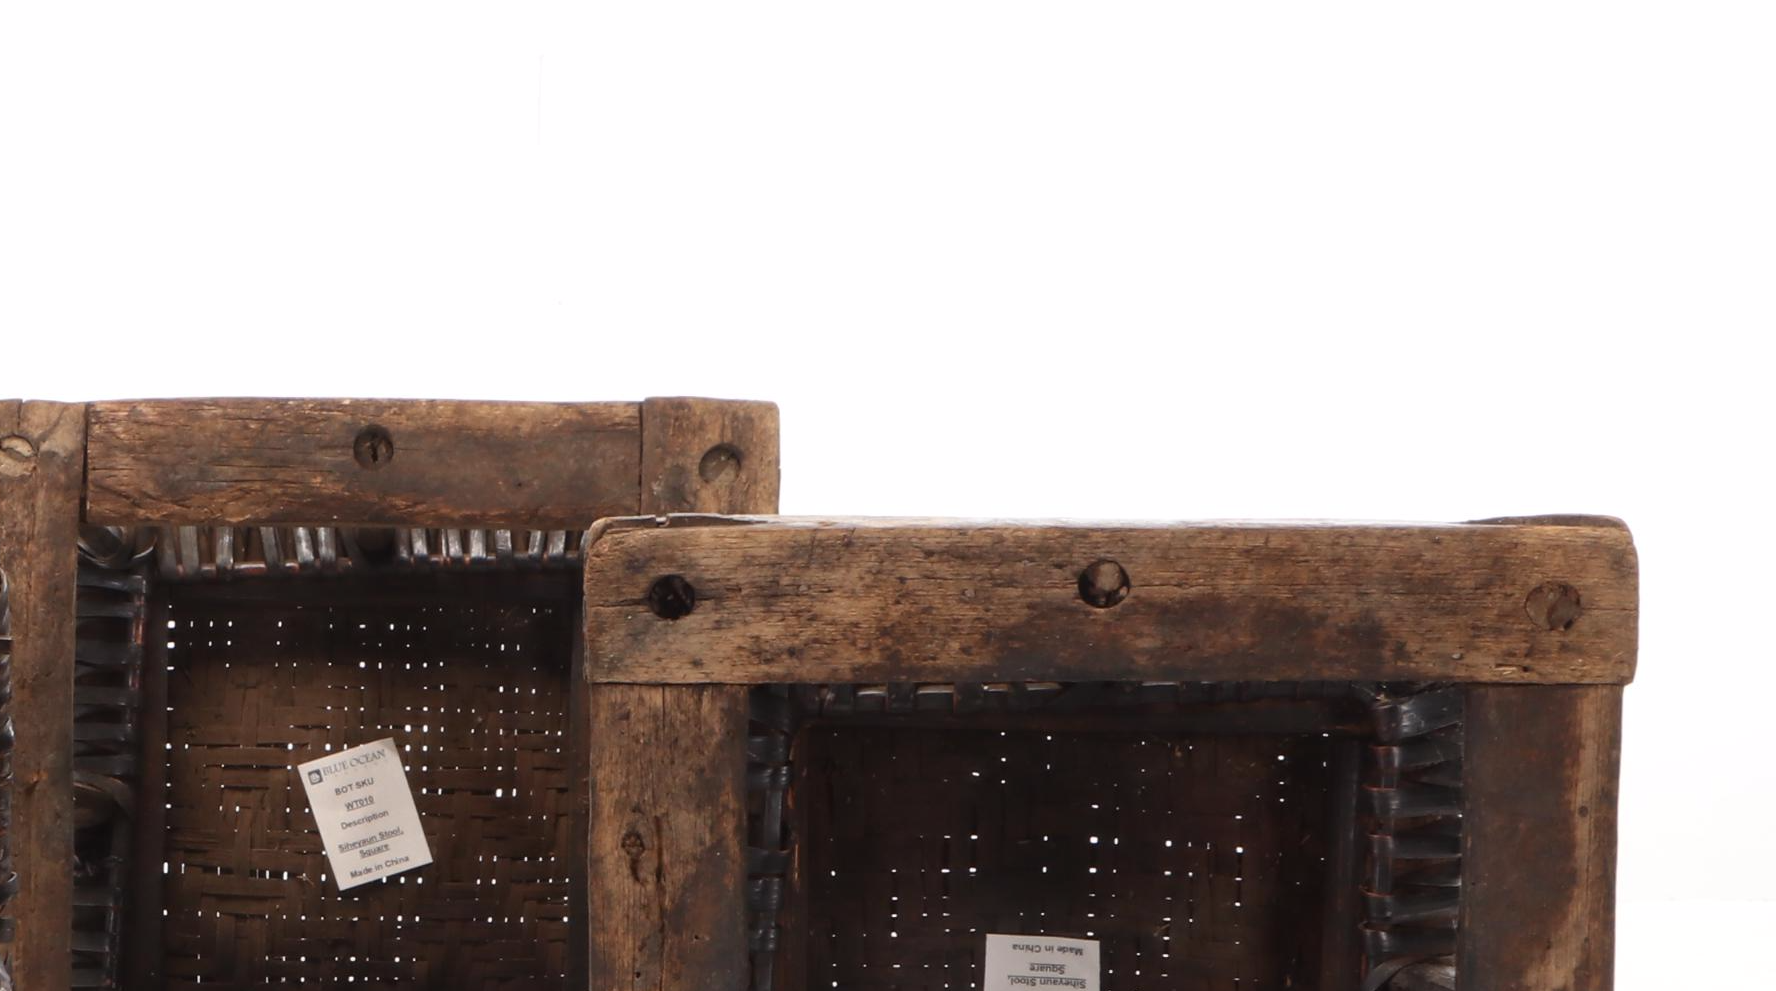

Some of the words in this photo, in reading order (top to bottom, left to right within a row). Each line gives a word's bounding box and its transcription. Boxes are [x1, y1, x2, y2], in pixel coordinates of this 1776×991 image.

[323, 760, 348, 776] BLUE
[350, 749, 385, 767] OCEAN
[335, 784, 355, 795] BOT
[356, 778, 374, 788] SKU
[340, 809, 389, 829] Description
[359, 843, 390, 858] Square
[350, 865, 373, 878] Made
[375, 863, 384, 871] in
[385, 855, 409, 868] China
[1012, 944, 1041, 952] China
[1045, 945, 1054, 953] in
[1057, 946, 1083, 955] Made
[1029, 963, 1066, 974] Square
